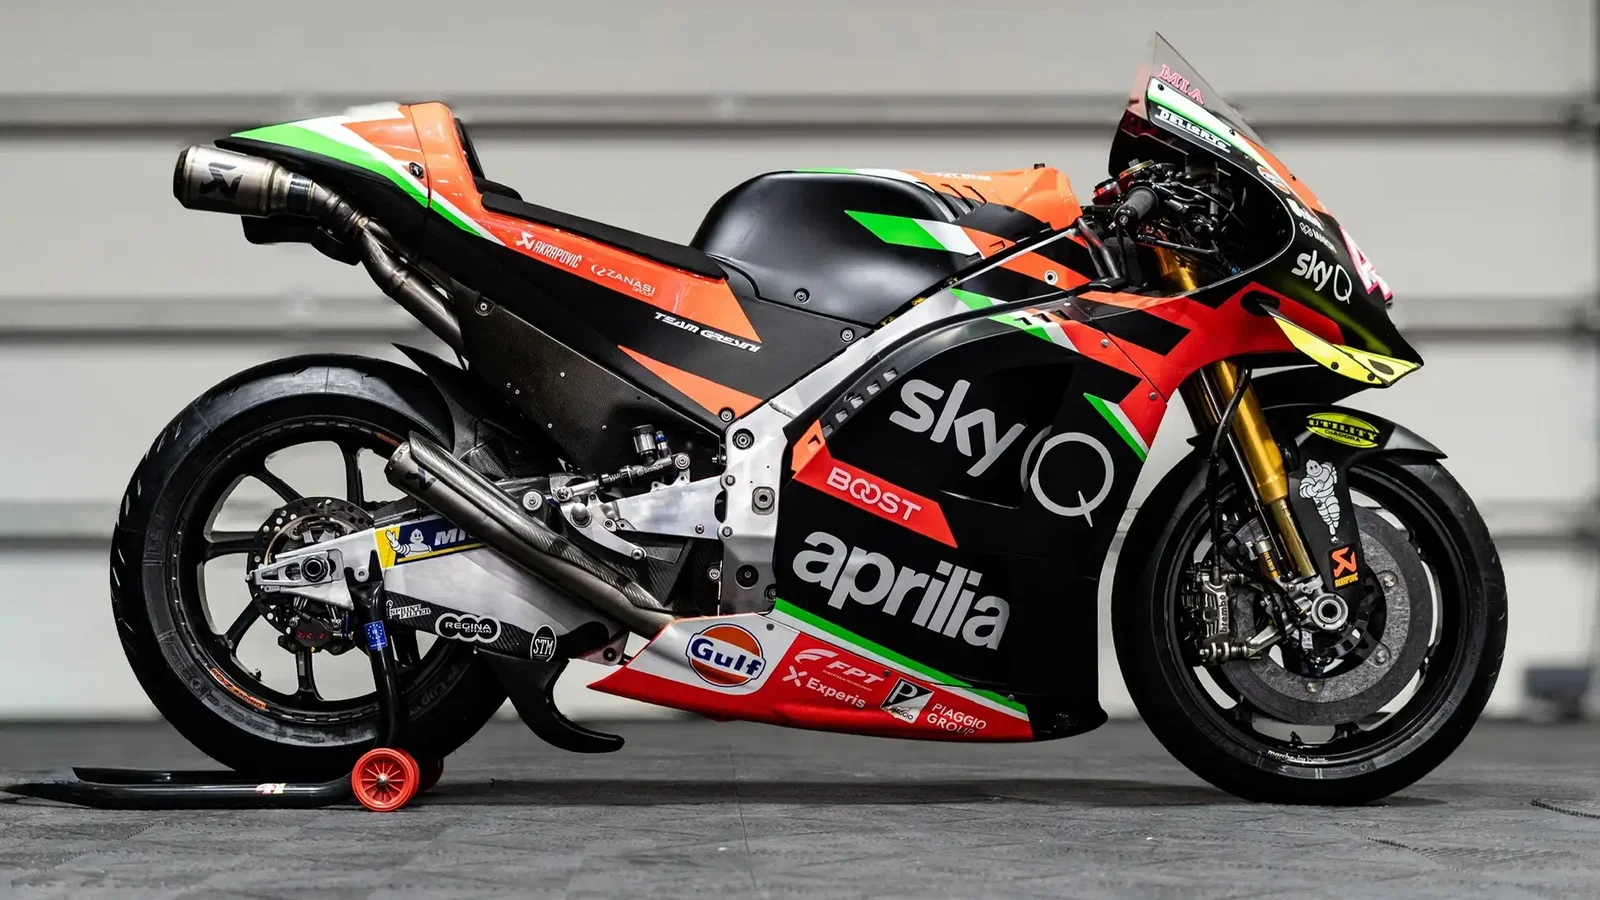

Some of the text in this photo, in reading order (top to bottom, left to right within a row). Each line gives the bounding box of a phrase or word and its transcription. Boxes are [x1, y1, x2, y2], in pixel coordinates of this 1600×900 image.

[1159, 64, 1205, 105] MIA
[607, 269, 656, 295] ZANASI
[1291, 250, 1353, 304] sky Q
[654, 312, 762, 353] TEAM GRESINI
[1308, 419, 1378, 442] UTILITY
[1324, 429, 1362, 443] DIADORA
[889, 379, 1115, 528] sky Q
[826, 466, 922, 521] BOOST
[792, 531, 1010, 650] aprilia
[445, 621, 491, 630] REGINA
[1219, 595, 1228, 633] brembo
[533, 639, 554, 655] STM
[691, 638, 763, 676] Gulf
[826, 661, 884, 684] FPT
[806, 676, 867, 709] Experis
[927, 713, 975, 735] GROUP
[931, 703, 987, 730] PIAGGIO
